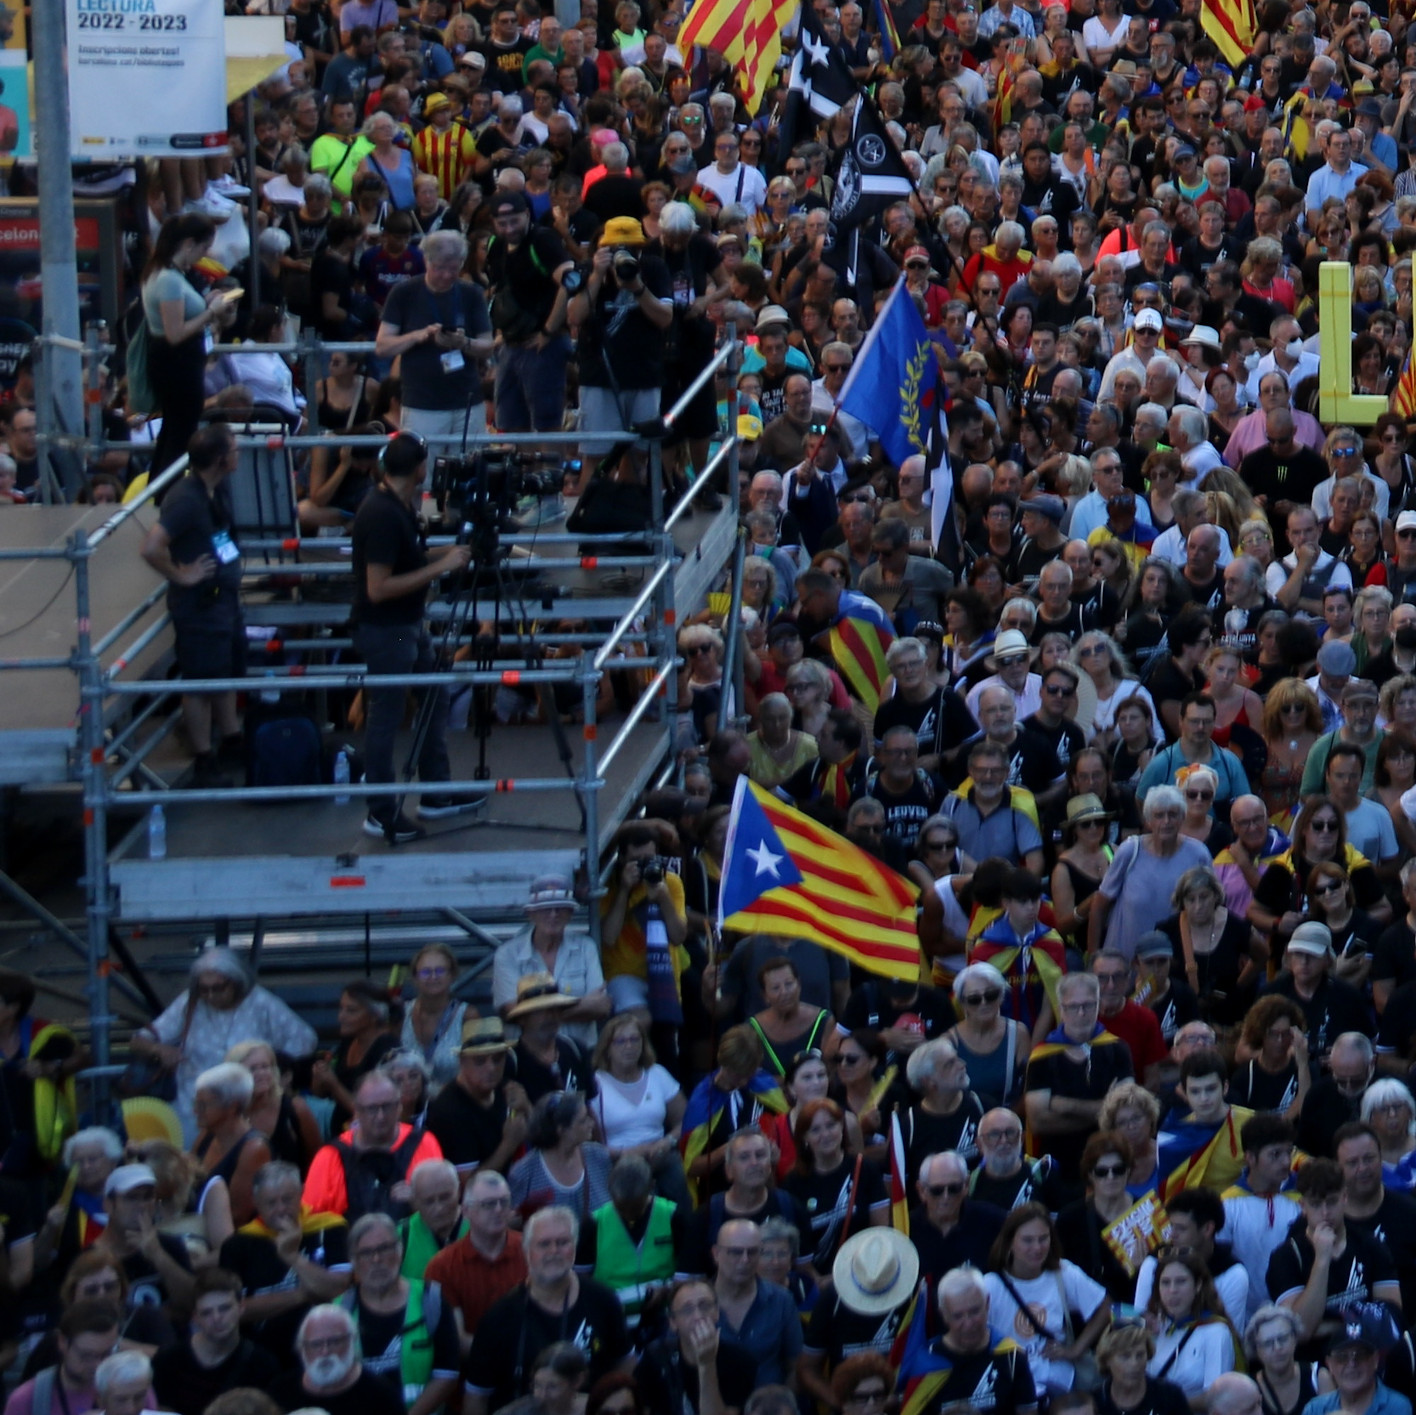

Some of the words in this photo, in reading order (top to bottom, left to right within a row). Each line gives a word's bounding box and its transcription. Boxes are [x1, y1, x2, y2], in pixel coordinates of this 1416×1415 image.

[78, 13, 125, 29] 2022
[139, 14, 187, 31] 2023
[888, 805, 928, 820] LEUVEN
